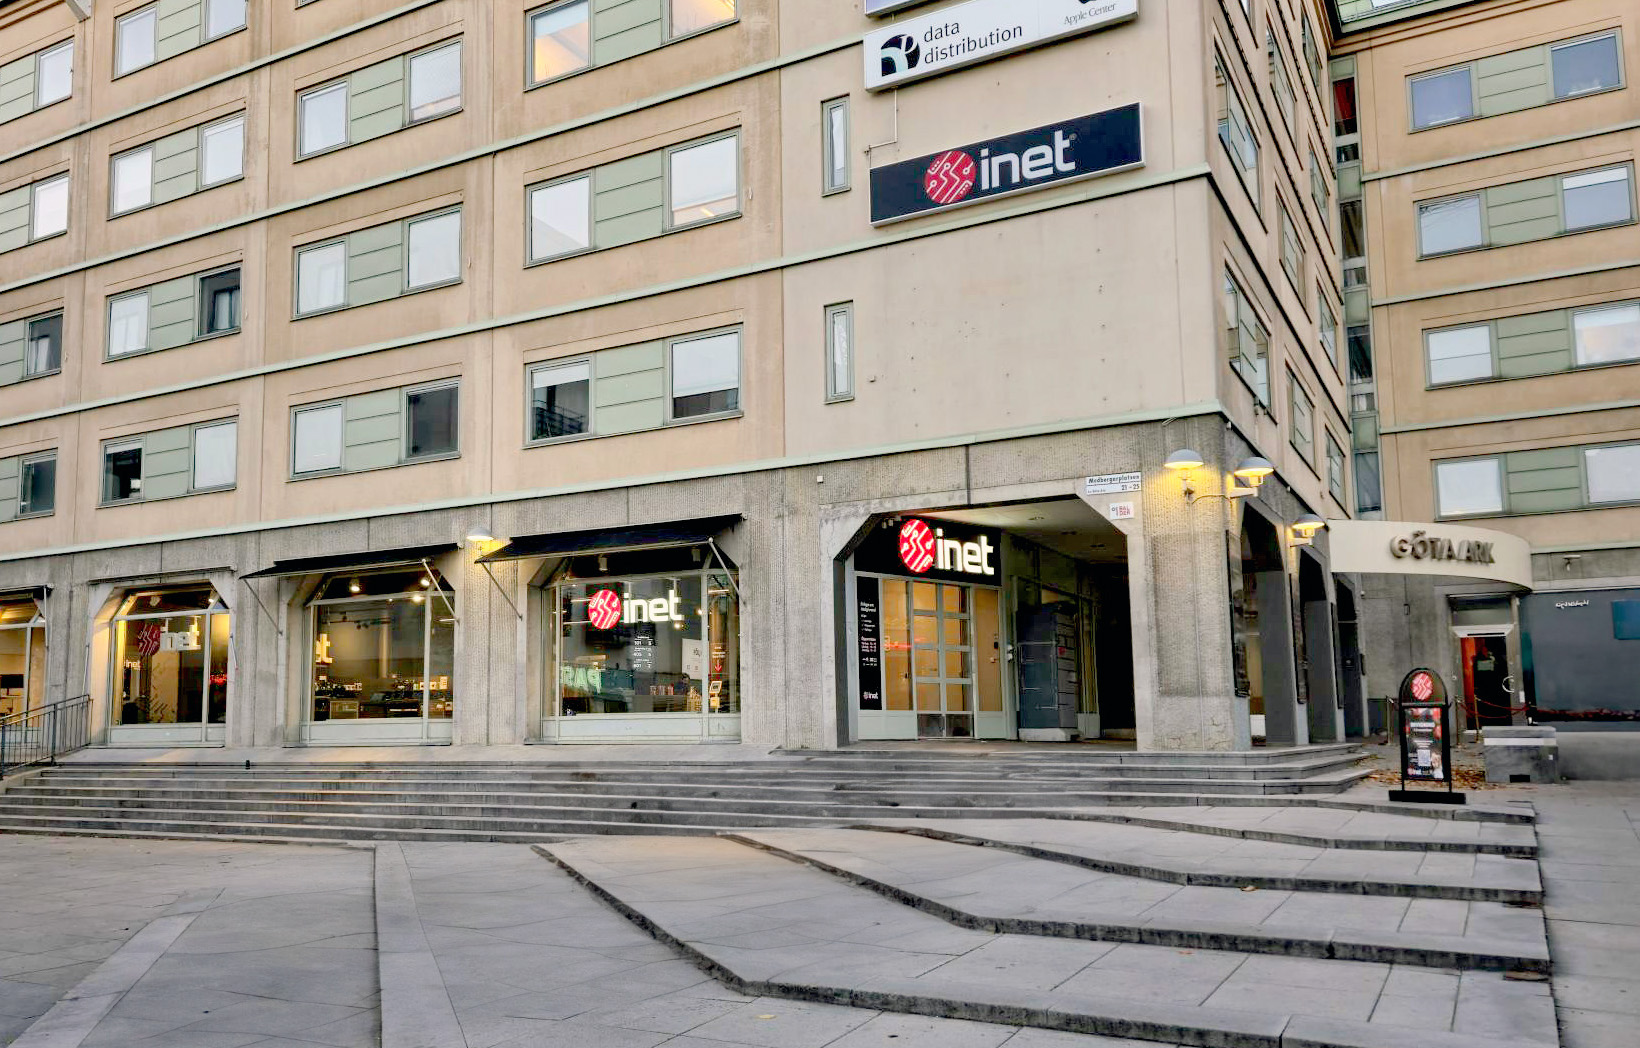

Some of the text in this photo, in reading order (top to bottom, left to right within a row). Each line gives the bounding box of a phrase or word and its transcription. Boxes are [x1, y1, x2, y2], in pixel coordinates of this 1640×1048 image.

[923, 21, 960, 43] data
[1063, 3, 1117, 26] Apple Center
[924, 25, 1023, 65] distribution
[981, 129, 1076, 190] inet
[936, 528, 994, 575] inet
[1390, 530, 1496, 566] GÖTA ARK
[623, 589, 683, 623] inet
